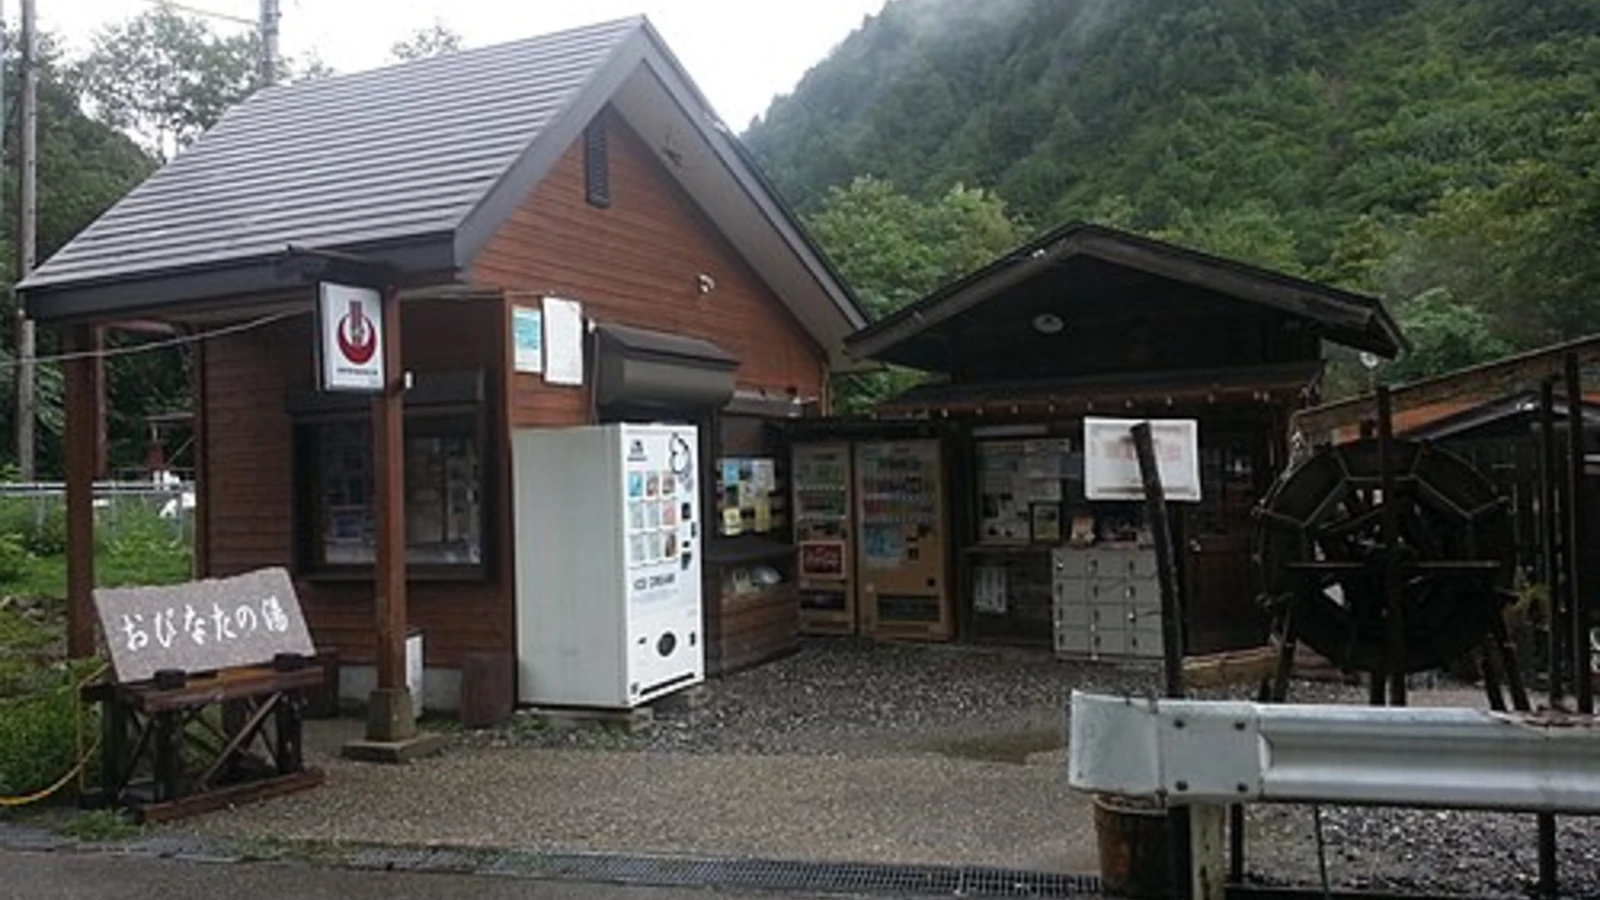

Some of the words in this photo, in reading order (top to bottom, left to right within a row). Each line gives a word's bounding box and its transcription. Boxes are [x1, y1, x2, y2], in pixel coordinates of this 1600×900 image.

[121, 595, 289, 650] おびなたの湯
